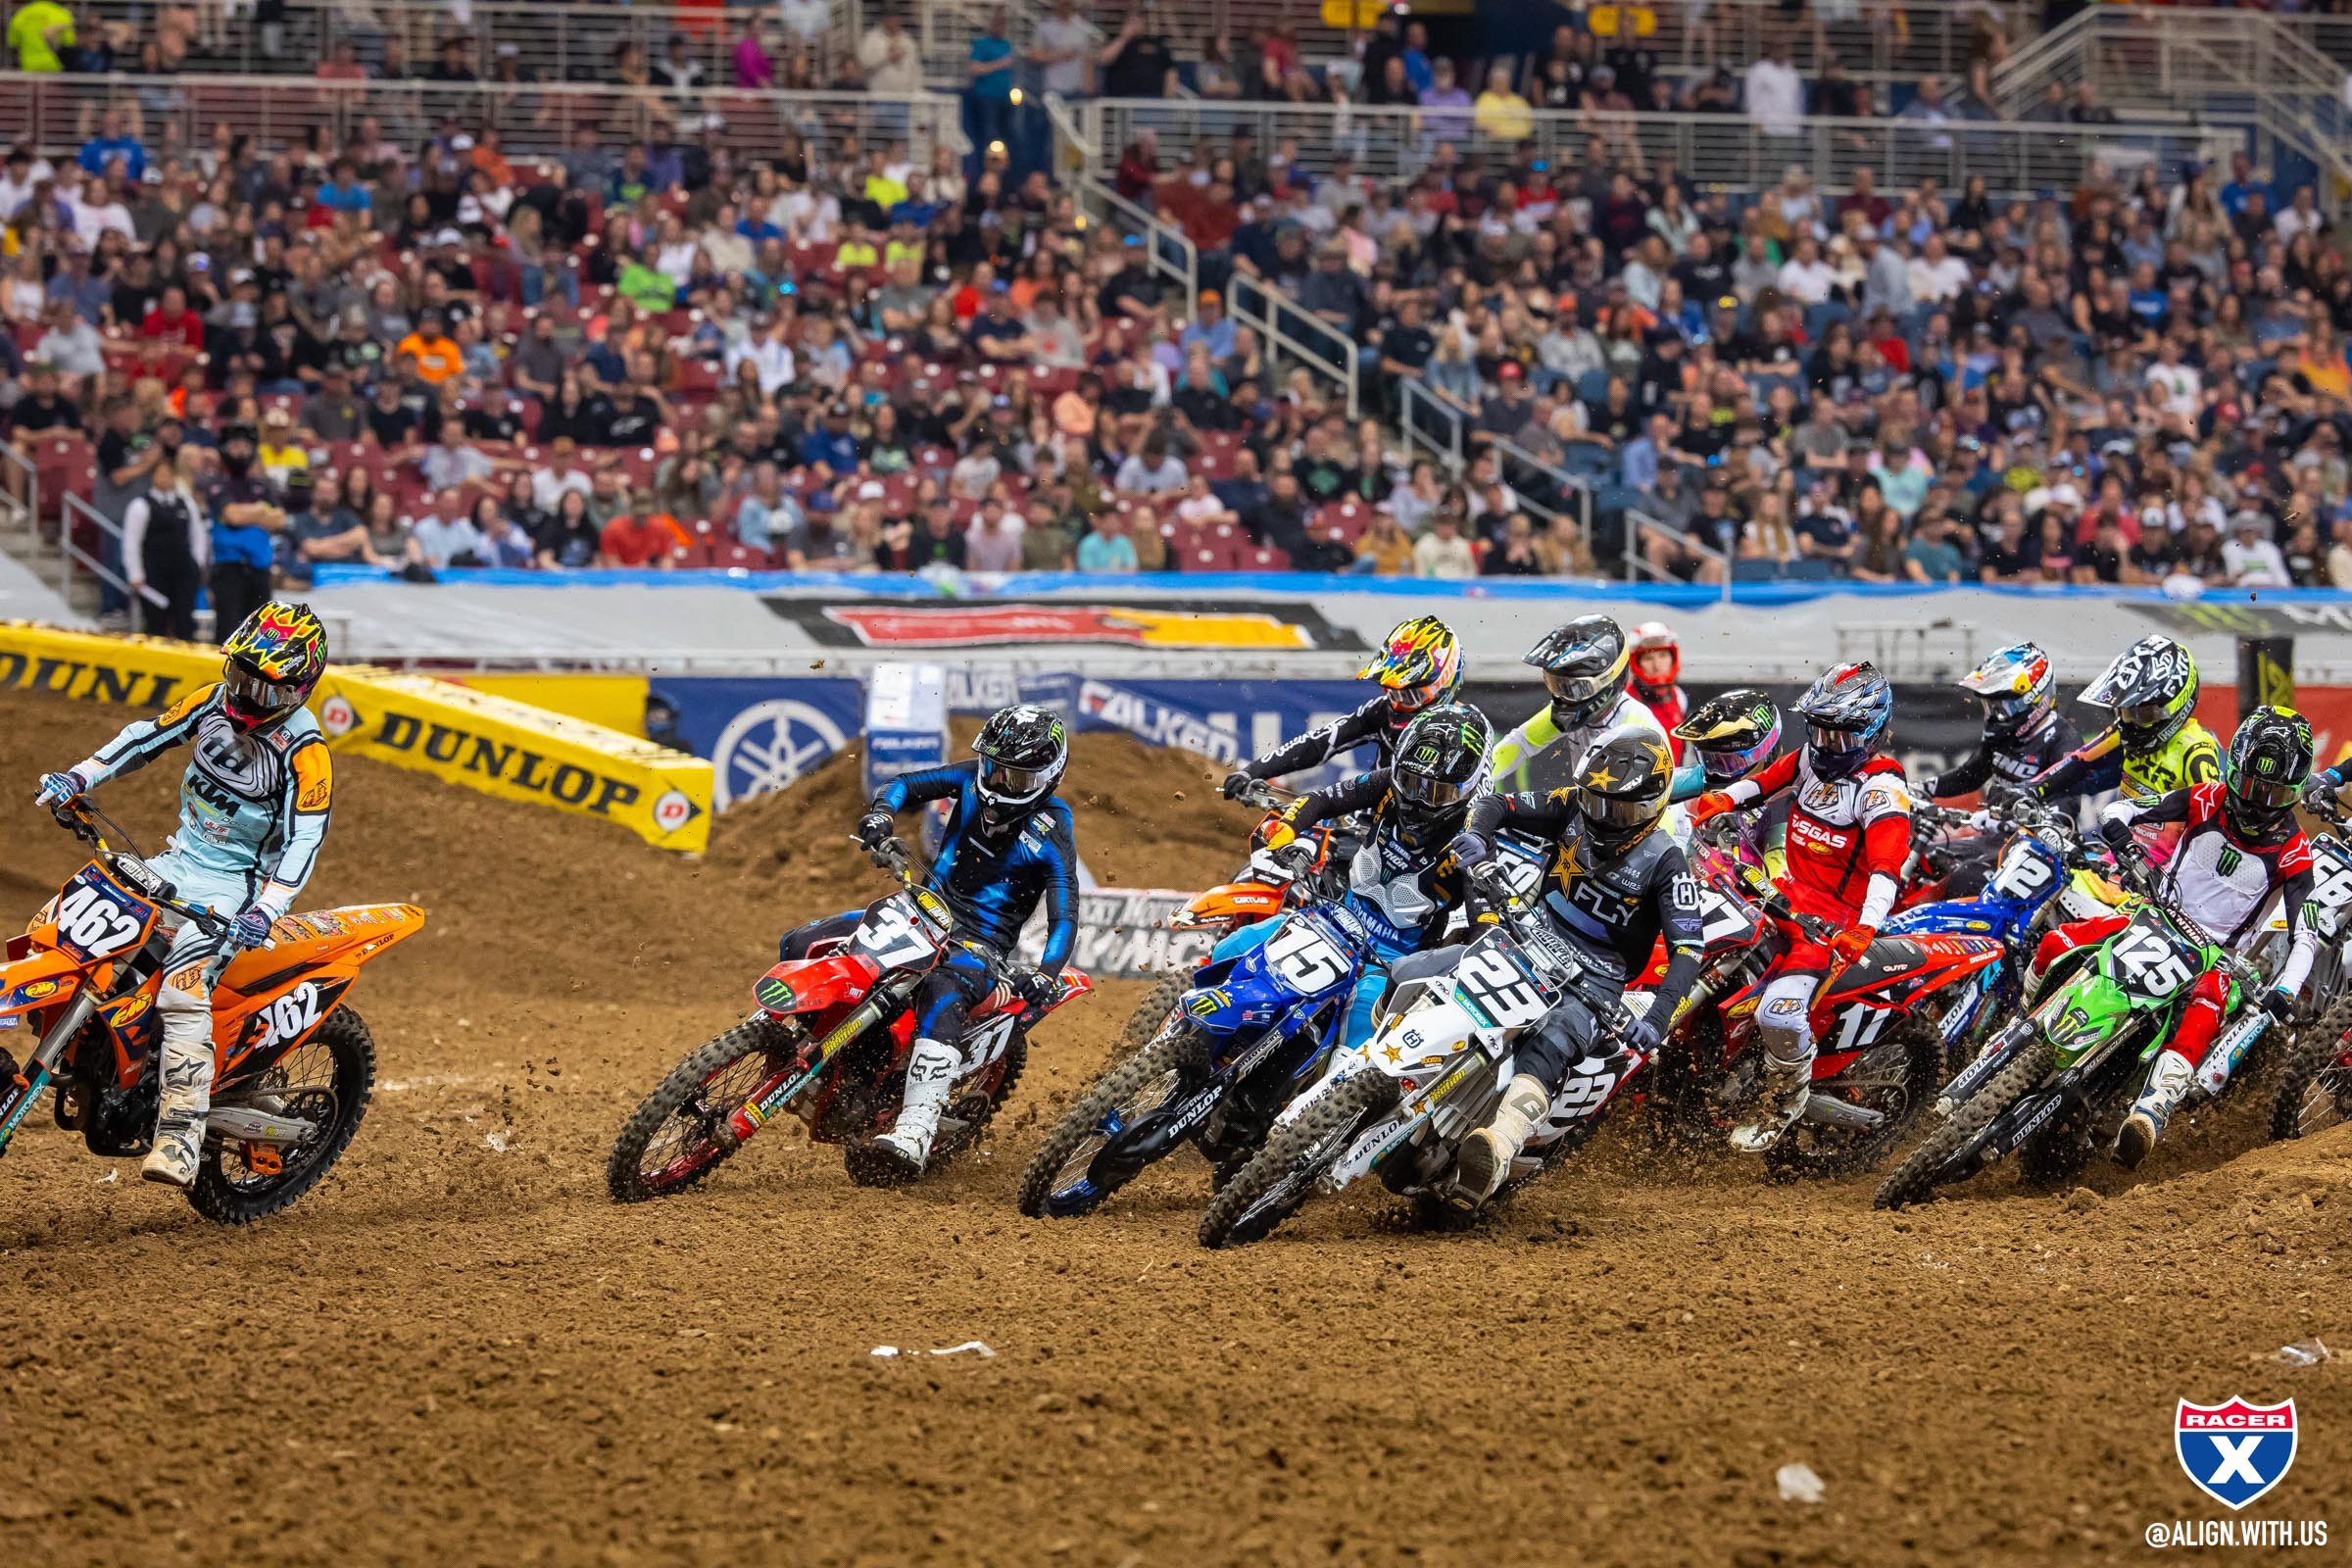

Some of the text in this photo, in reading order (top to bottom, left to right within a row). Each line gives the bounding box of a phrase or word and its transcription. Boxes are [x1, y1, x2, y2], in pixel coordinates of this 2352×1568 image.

[371, 710, 641, 816] DUNLOP
[186, 773, 242, 818] KTM
[57, 885, 141, 958] 462
[1357, 907, 1400, 942] YAMAHA
[1573, 881, 1641, 927] FLY
[856, 906, 937, 969] 37
[1265, 925, 1351, 993] 15
[2112, 924, 2194, 997] 125
[1458, 949, 1550, 1028] 23
[1462, 998, 1489, 1028] MOTOREX
[9, 1082, 47, 1129] MOTOREX
[776, 1072, 815, 1107] MOTOREX
[1167, 1084, 1223, 1139] DUNLOP
[1551, 1072, 1616, 1118] 23
[2012, 1094, 2062, 1147] DUNLOP
